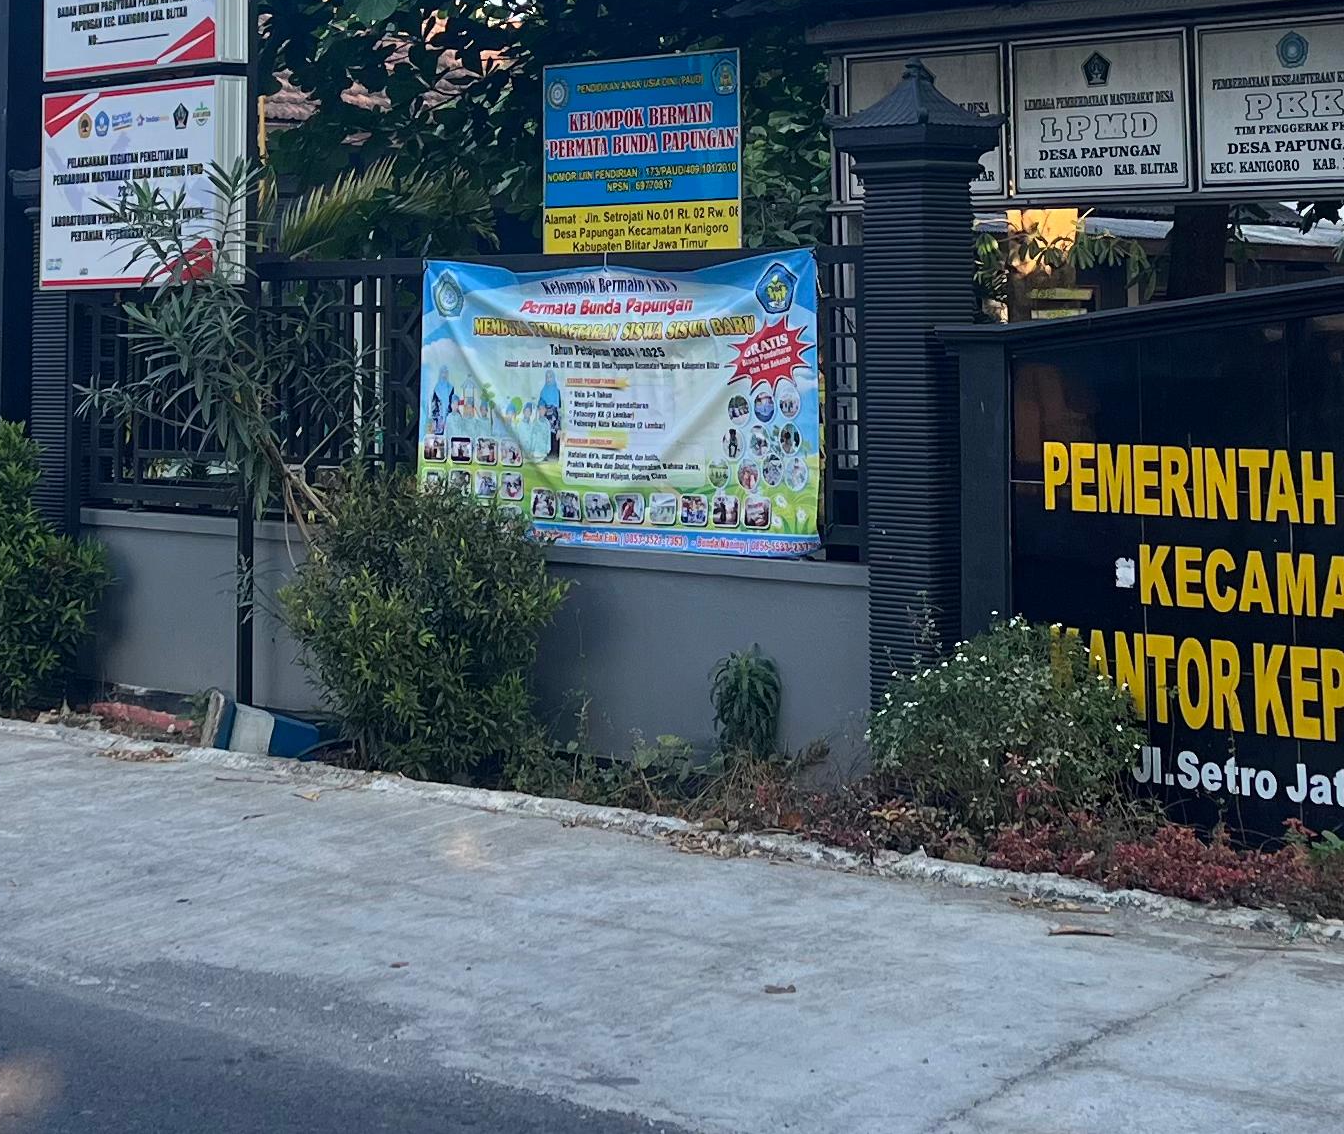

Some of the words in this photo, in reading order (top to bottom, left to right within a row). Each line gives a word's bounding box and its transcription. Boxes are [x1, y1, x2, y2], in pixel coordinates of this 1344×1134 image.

[577, 82, 620, 94] PENDIDIKAN
[621, 80, 641, 90] ANAK
[644, 78, 661, 88] USIA
[1156, 90, 1174, 102] DESA
[569, 108, 645, 133] KELOMPOK
[648, 102, 713, 127] BERMAIN
[1040, 111, 1158, 143] LPMD
[1235, 126, 1256, 135] TIM
[1259, 122, 1329, 134] PENGGERAK
[611, 134, 657, 156] BUNDA
[1039, 148, 1077, 161] DESA
[1081, 144, 1161, 159] PAPUNGAN
[1227, 142, 1271, 155] DESA
[1024, 168, 1047, 179] KEC.
[1049, 165, 1103, 178] KANIGORO
[1114, 164, 1138, 176] KAB.
[1140, 162, 1178, 174] BLITAR
[1210, 162, 1236, 174] KEC.
[1239, 159, 1300, 174] KANIGORO
[1312, 158, 1339, 171] KAB.
[547, 172, 576, 183] NOMOR
[595, 168, 638, 180] PENDIRIAN
[607, 182, 628, 192] NPSN
[544, 213, 576, 225] Alamat
[603, 209, 644, 224] Setrojati
[693, 208, 704, 219] 02
[554, 228, 577, 239] Desa
[579, 227, 625, 241] Papungan
[628, 224, 682, 237] Kecamatan
[684, 222, 728, 237] Kanigoro
[573, 241, 622, 253] Kabupaten
[625, 240, 650, 251] Blitar
[653, 239, 677, 250] Jawa
[680, 237, 708, 248] Timur
[541, 277, 596, 296] Kelompok
[598, 277, 646, 293] Bermain
[519, 300, 576, 315] Permata
[580, 299, 621, 315] Bunda
[625, 298, 693, 316] Papungan
[620, 321, 663, 341] SISWA
[665, 319, 709, 340] SISWI
[710, 314, 755, 337] BARU
[550, 344, 574, 356] Tahun
[610, 346, 635, 358] 2024
[640, 346, 665, 358] 2025
[744, 333, 788, 358] GRATIS
[1043, 441, 1336, 525] PEMERINTAH
